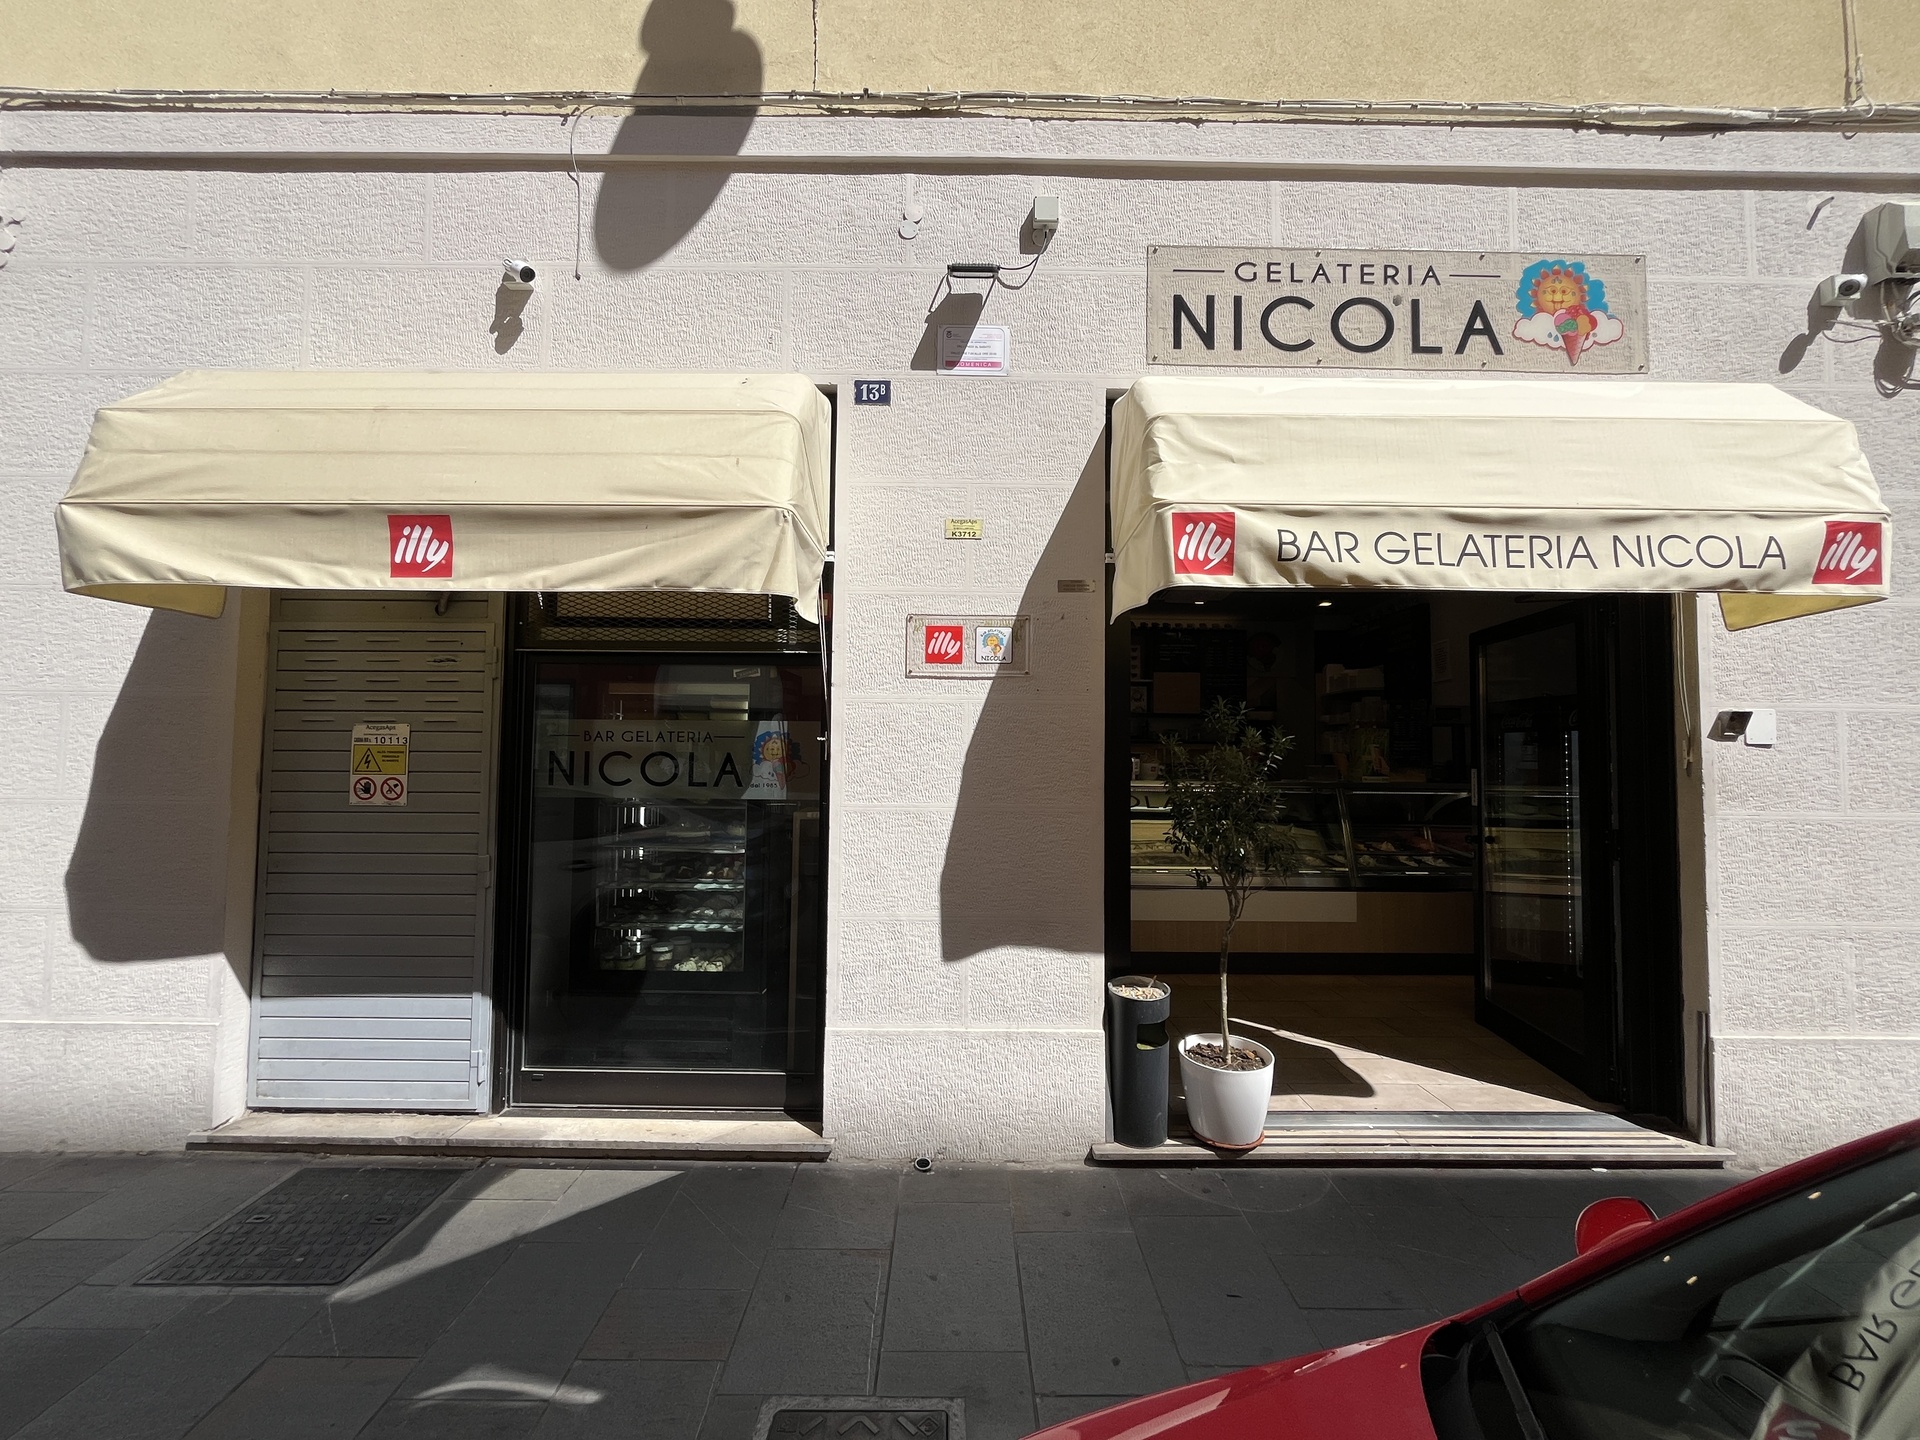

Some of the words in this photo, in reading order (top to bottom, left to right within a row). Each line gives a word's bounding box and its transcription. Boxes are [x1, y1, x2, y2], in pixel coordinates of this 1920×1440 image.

[1234, 261, 1442, 287] GELATERIA
[1172, 294, 1505, 356] NICOLA
[394, 524, 450, 573] illy
[1177, 521, 1232, 571] illy
[1276, 528, 1361, 565] BAR
[1373, 531, 1598, 571] GELATERIA
[1613, 534, 1787, 570] NICOLA
[1819, 530, 1878, 580] illy
[927, 631, 961, 660] illy
[583, 730, 615, 743] BAR
[621, 730, 714, 743] GELATERIA
[548, 750, 744, 788] NICOLA
